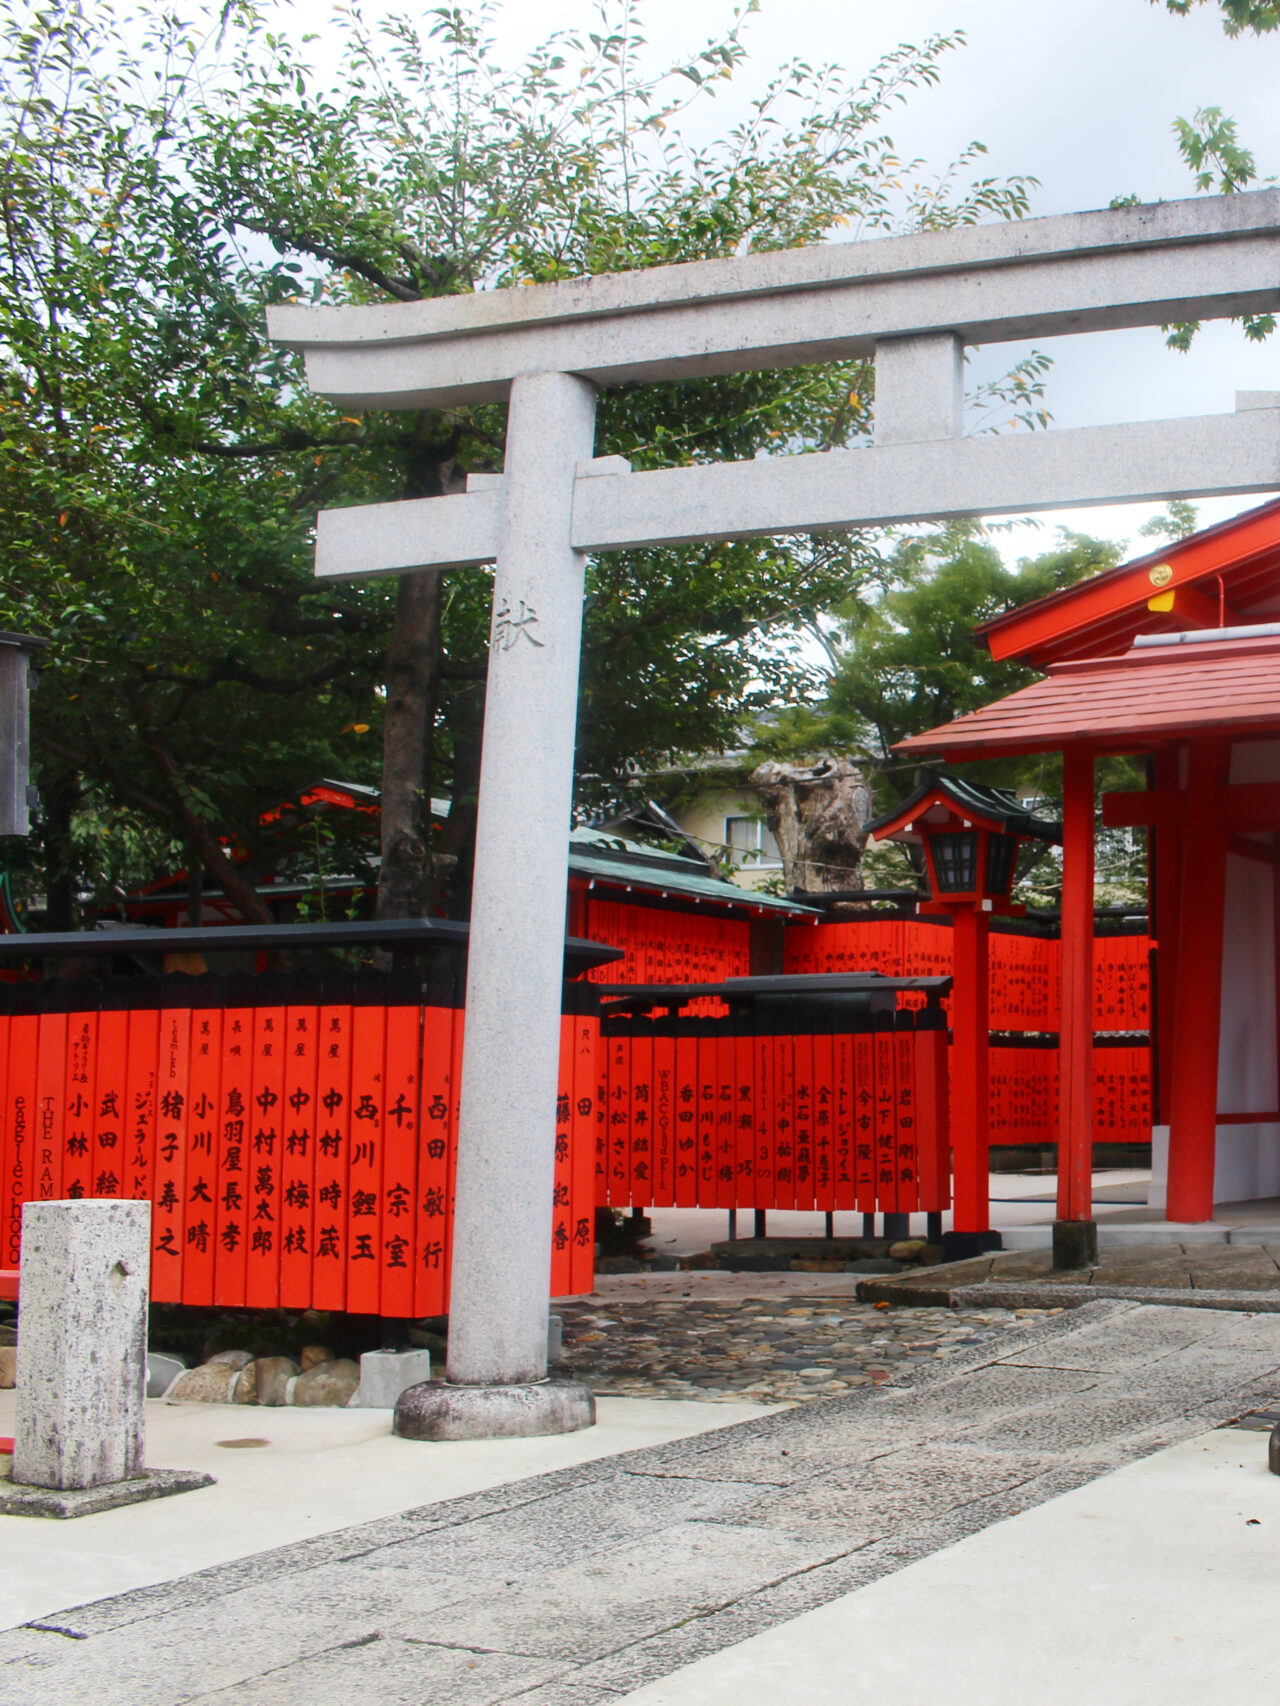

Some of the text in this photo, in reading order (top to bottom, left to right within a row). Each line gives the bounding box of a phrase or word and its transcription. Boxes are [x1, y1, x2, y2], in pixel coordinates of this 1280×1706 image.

[493, 598, 545, 653] 献
[40, 1097, 55, 1201] THE RAM
[95, 1090, 119, 1194] 武田絵
[187, 1093, 214, 1254] 小川大晴
[251, 1086, 278, 1257] 中村萬太郎
[283, 1087, 311, 1255] 中村梅枝
[316, 1087, 343, 1259] 中村時蔵
[384, 1094, 412, 1268] 千宗室
[422, 1095, 448, 1269] 西田敏行
[552, 1092, 571, 1250] 藤原紀香
